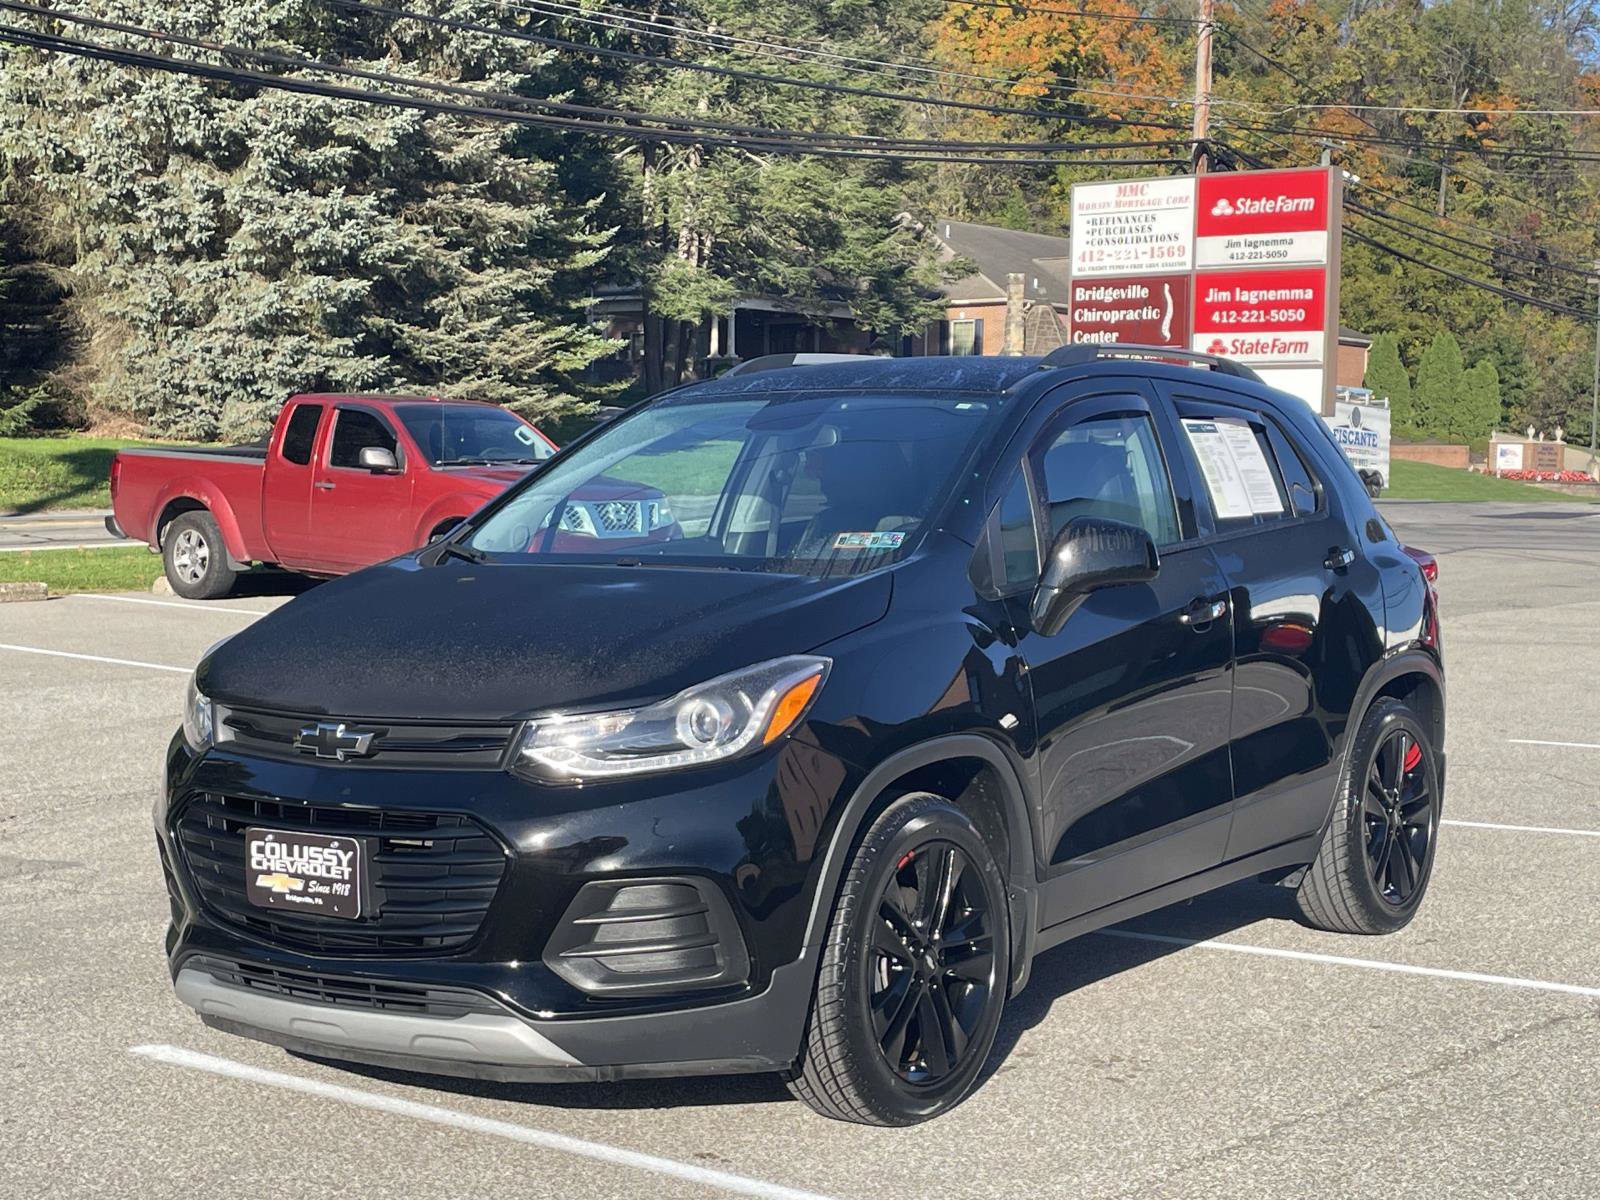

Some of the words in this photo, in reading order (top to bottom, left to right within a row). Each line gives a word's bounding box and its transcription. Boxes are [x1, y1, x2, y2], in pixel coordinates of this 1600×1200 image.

[1115, 184, 1150, 197] MMC
[1224, 238, 1242, 249] Jim
[1243, 238, 1294, 250] Iagnemma
[1078, 245, 1186, 263] 412-221-1569
[1228, 249, 1289, 260] 412-221-5050
[1075, 284, 1150, 303] Bridgeville
[1204, 287, 1231, 303] Jim
[1235, 287, 1314, 304] Iagnemma
[1074, 305, 1161, 324] Chiropractic
[1211, 308, 1306, 324] 412-221-5050
[1073, 330, 1119, 344] Center
[250, 840, 354, 868] COLUSSY
[250, 856, 352, 880] CHEVROLET
[307, 880, 331, 894] Since
[331, 882, 351, 896] 1918
